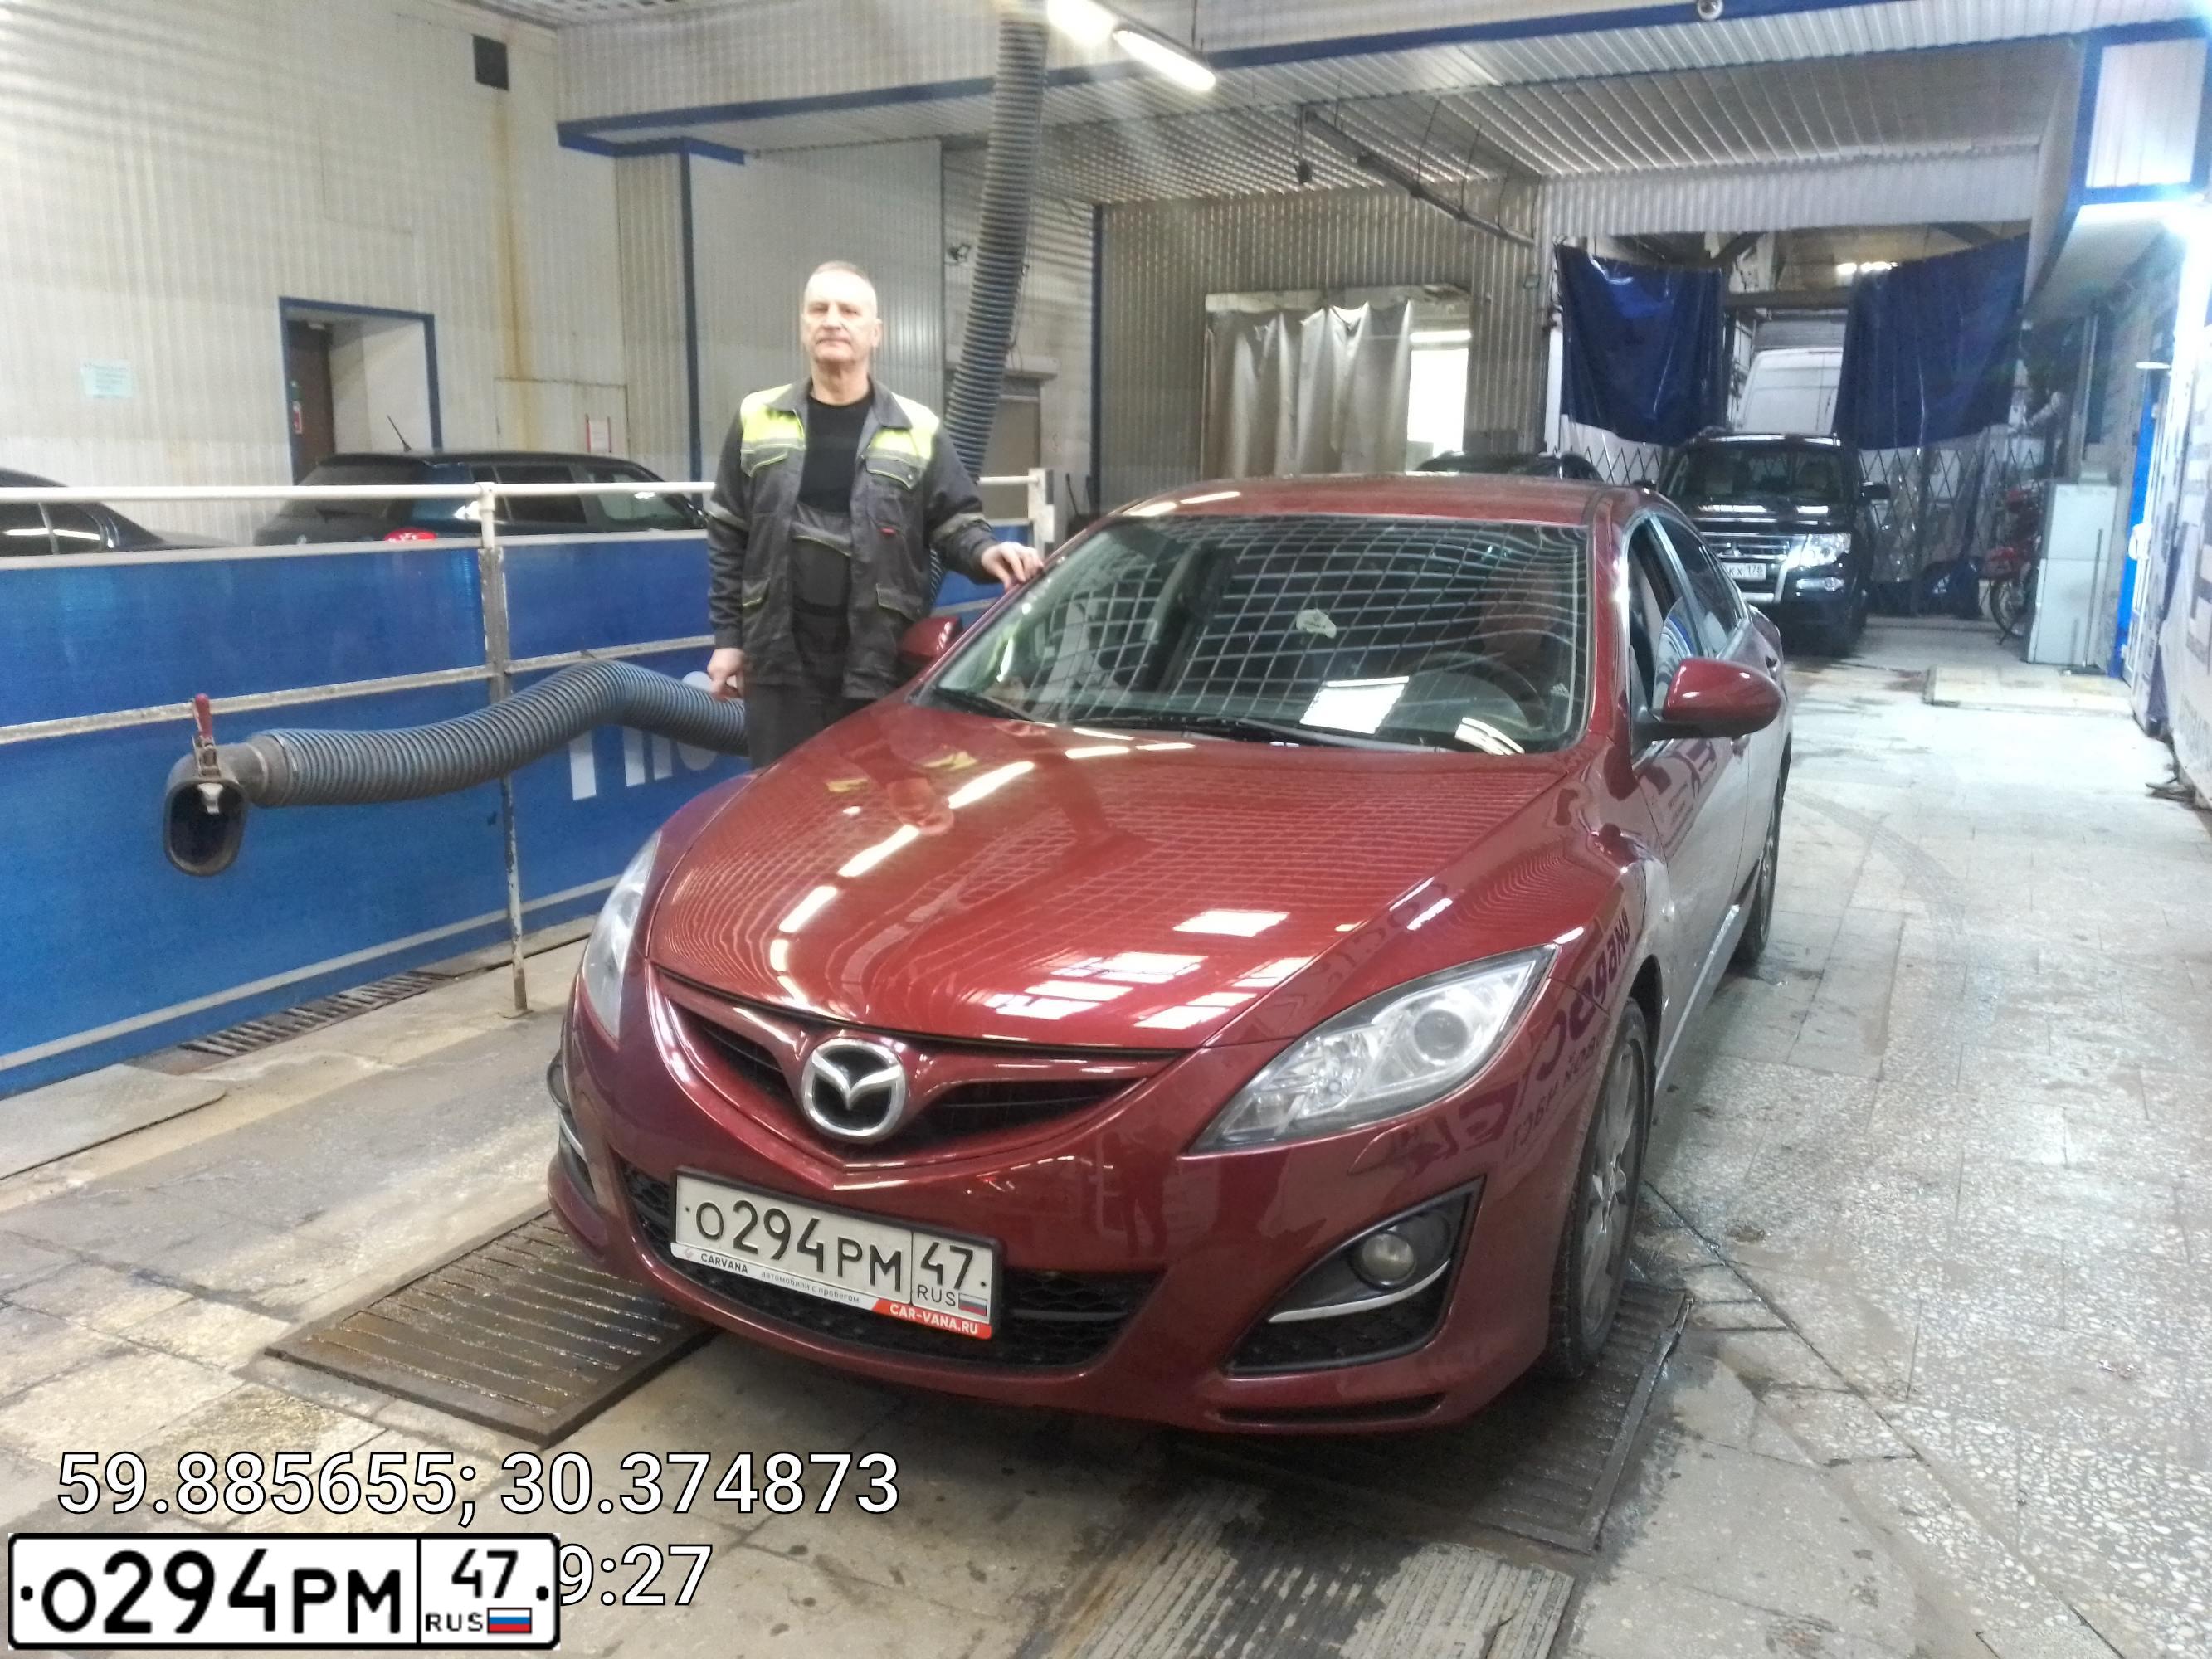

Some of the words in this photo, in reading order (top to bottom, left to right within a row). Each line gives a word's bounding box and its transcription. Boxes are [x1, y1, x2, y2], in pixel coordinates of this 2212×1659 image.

[700, 1253, 748, 1274] CARVANA
[920, 1241, 974, 1291] 47
[761, 1270, 811, 1291] автомобили
[818, 1287, 860, 1305] пробегом
[916, 1284, 957, 1307] RUS
[889, 1302, 979, 1335] CAR-VANA.RU
